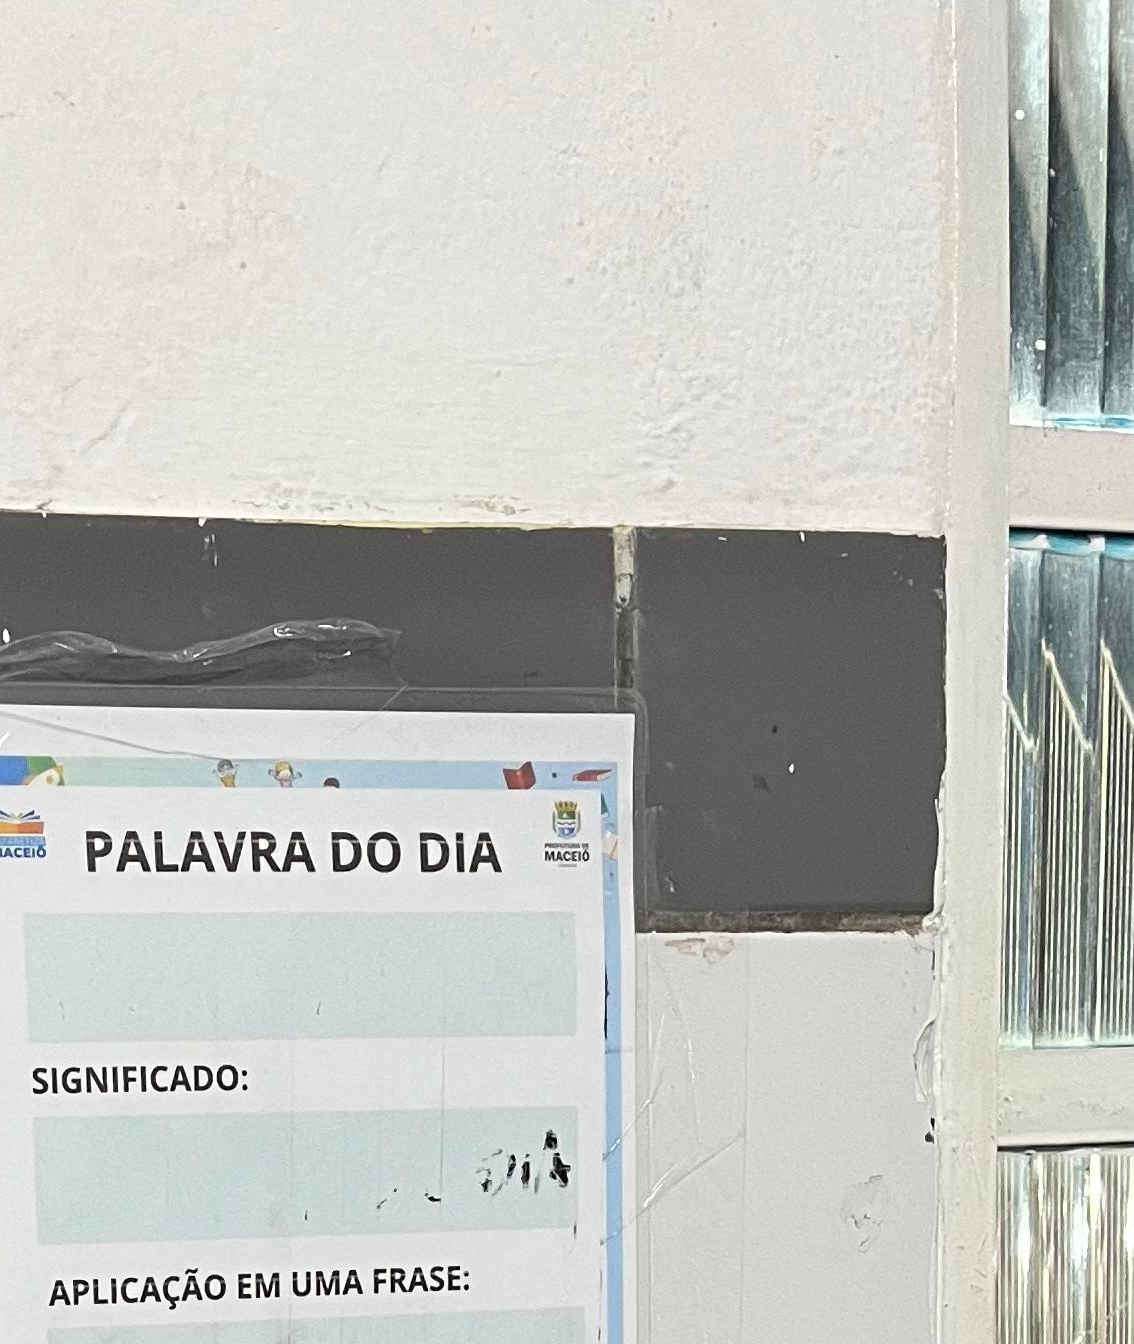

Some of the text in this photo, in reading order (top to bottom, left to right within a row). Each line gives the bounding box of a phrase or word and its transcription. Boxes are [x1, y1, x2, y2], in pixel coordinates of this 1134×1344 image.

[84, 830, 504, 873] PALAVRA DO DIA
[32, 1063, 249, 1095] SIGNIFICADO:
[48, 1264, 470, 1311] APLICAÇÃO EM UMA FRASE:
